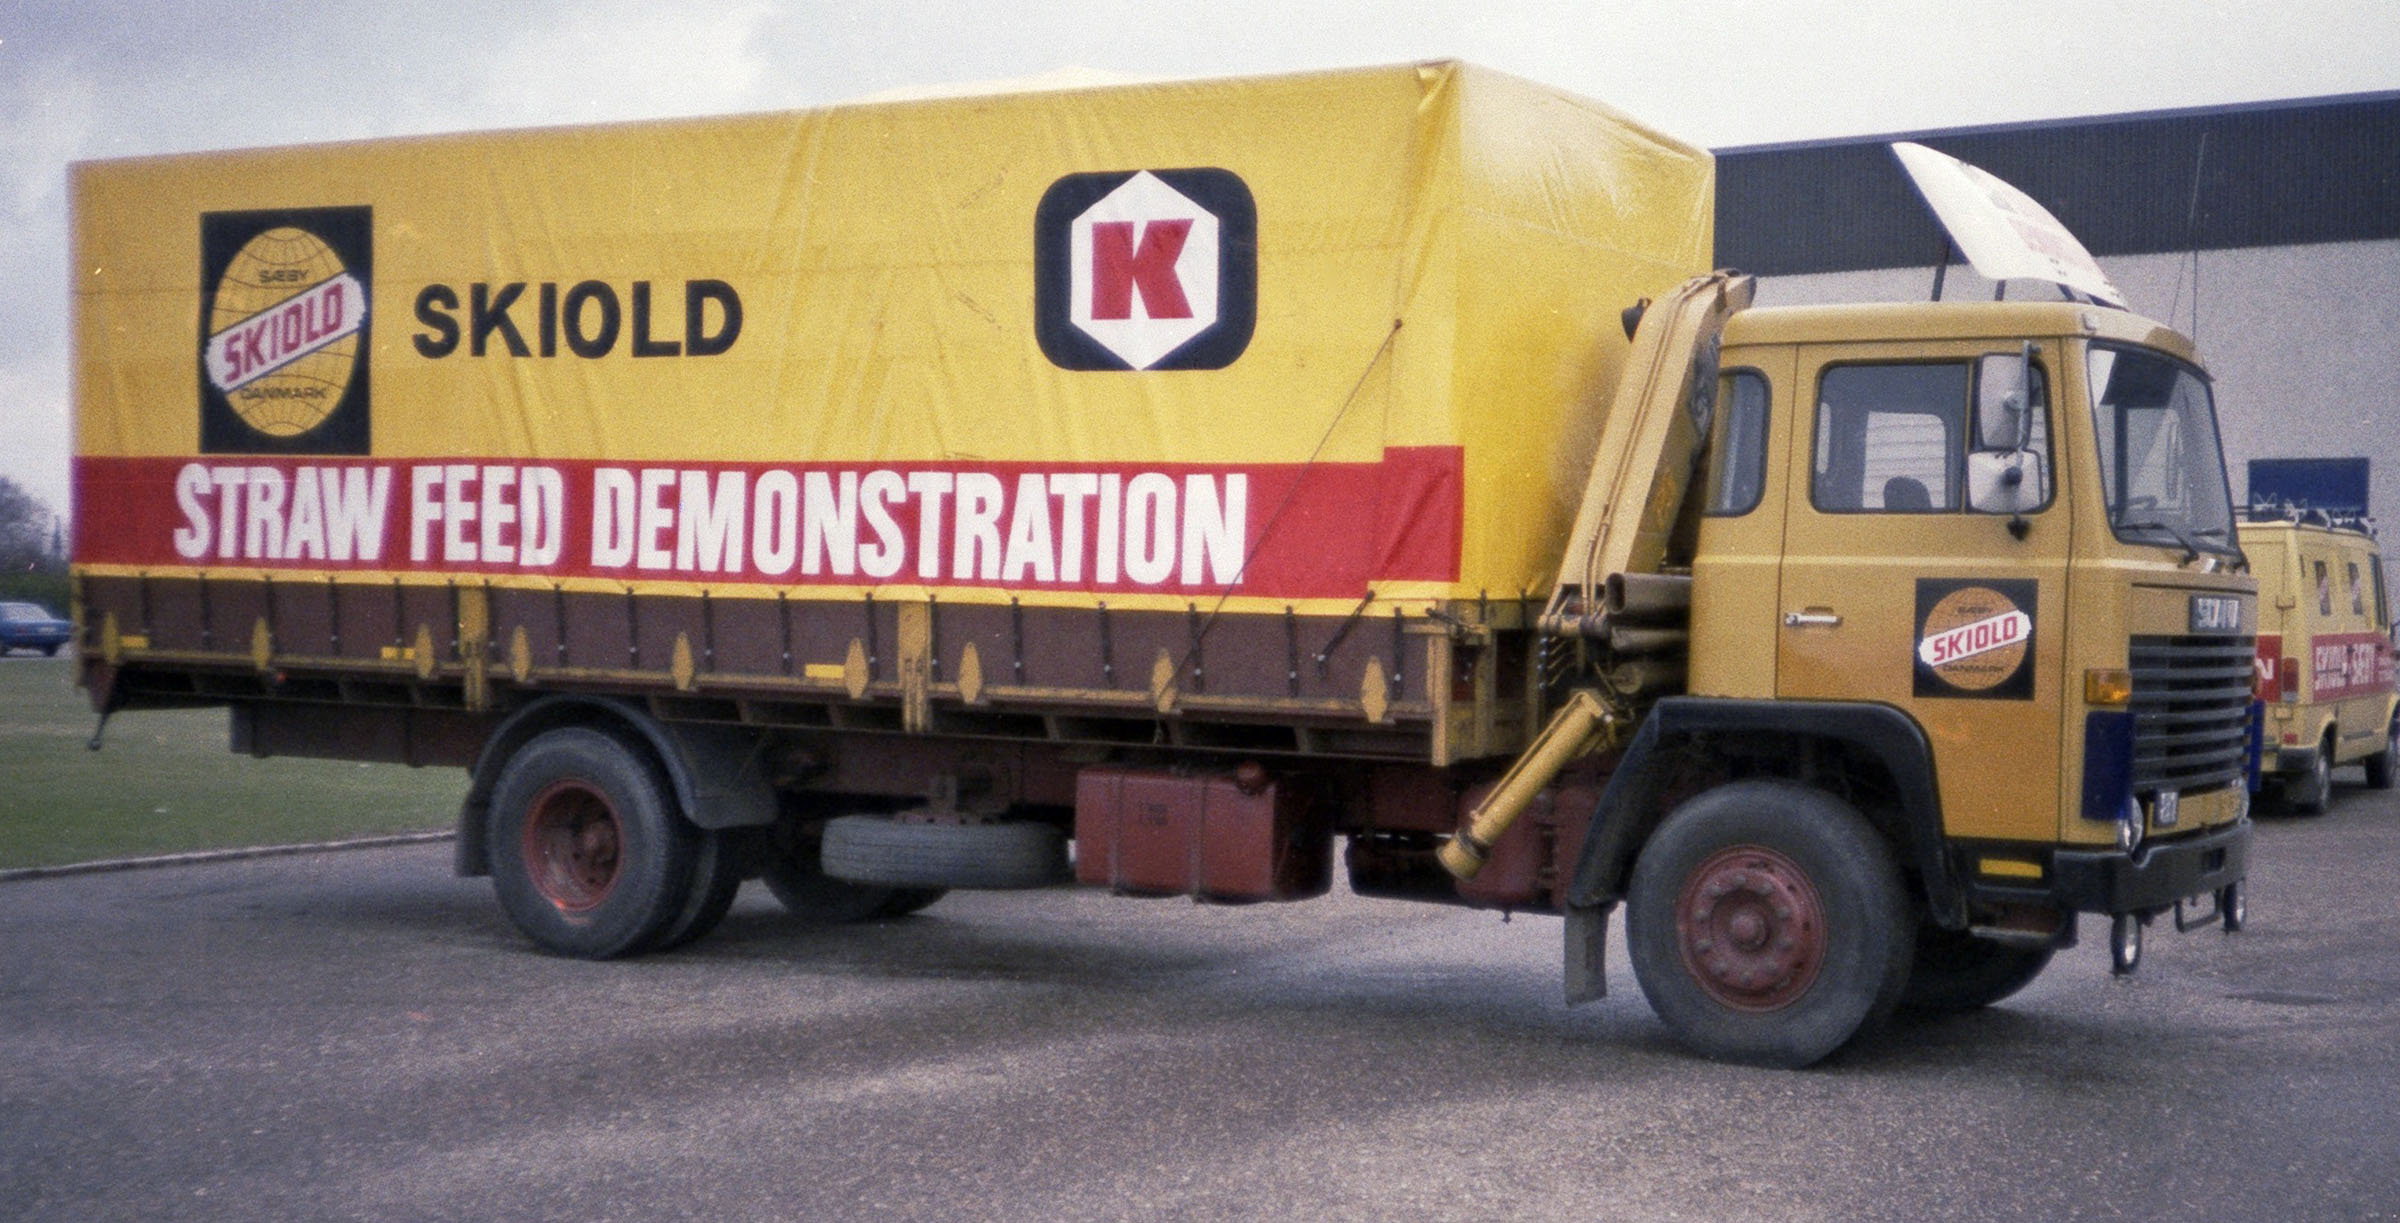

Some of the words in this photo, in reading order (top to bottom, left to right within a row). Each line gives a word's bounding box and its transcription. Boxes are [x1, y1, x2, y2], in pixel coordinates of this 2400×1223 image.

[1090, 217, 1195, 320] K
[224, 282, 344, 384] SKIOLD
[411, 278, 744, 358] SKIOLD
[240, 387, 327, 400] DANMARK
[173, 462, 392, 562] STRAW
[410, 463, 565, 567] FEED
[591, 466, 1249, 586] DEMONSTRATION
[1933, 615, 2018, 662] SKIOLD
